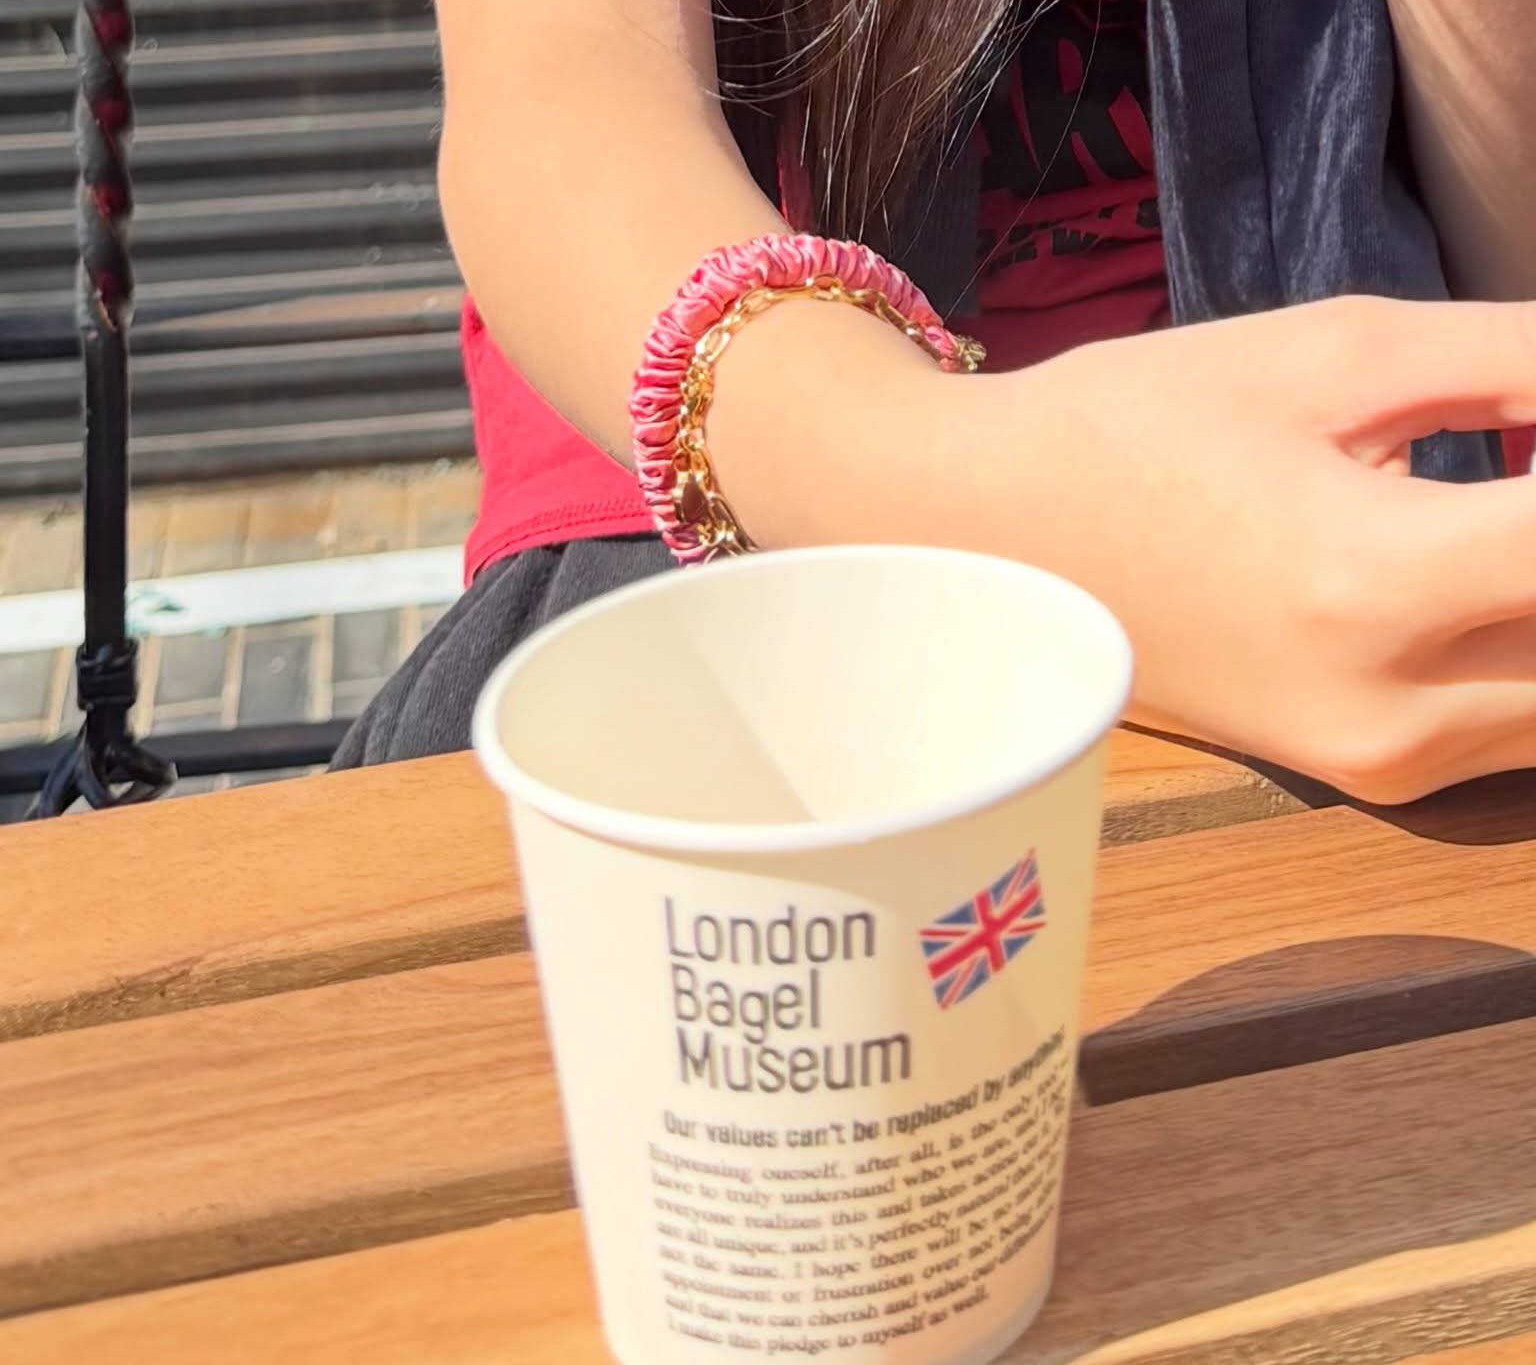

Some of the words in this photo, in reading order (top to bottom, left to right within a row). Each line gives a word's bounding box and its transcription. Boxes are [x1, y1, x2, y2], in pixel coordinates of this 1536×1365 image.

[664, 895, 875, 965] London
[671, 964, 820, 1045] Bagel
[677, 1027, 911, 1093] Museum
[664, 1109, 697, 1140] Our
[706, 1122, 778, 1147] values
[786, 1122, 846, 1147] can't
[853, 1119, 879, 1142] be
[887, 1084, 980, 1137] replaced
[984, 1075, 1005, 1102] by
[699, 1183, 717, 1199] to
[726, 1189, 771, 1208] truly
[782, 1176, 896, 1204] understand
[904, 1165, 946, 1185] who
[855, 1154, 902, 1175] after
[655, 1198, 735, 1225] everyone
[745, 1213, 822, 1229] realizes
[832, 1210, 867, 1226] this
[876, 1198, 912, 1219] and
[921, 1184, 966, 1207] takes
[687, 1228, 707, 1244] all
[791, 1238, 825, 1253] and
[833, 1233, 864, 1251] it's
[869, 1209, 951, 1250] perfectly
[795, 1262, 801, 1277] I
[813, 1262, 861, 1279] hope
[870, 1249, 918, 1268] there
[927, 1228, 960, 1251] will
[814, 1273, 914, 1301] frustration
[923, 1253, 963, 1278] over
[738, 1312, 763, 1326] we
[769, 1315, 801, 1326] can
[808, 1304, 879, 1326] cherish
[884, 1292, 918, 1315] and
[923, 1275, 970, 1302] value
[728, 1333, 761, 1349] this
[768, 1336, 830, 1355] pledge
[837, 1335, 855, 1347] to
[861, 1311, 926, 1345] myself
